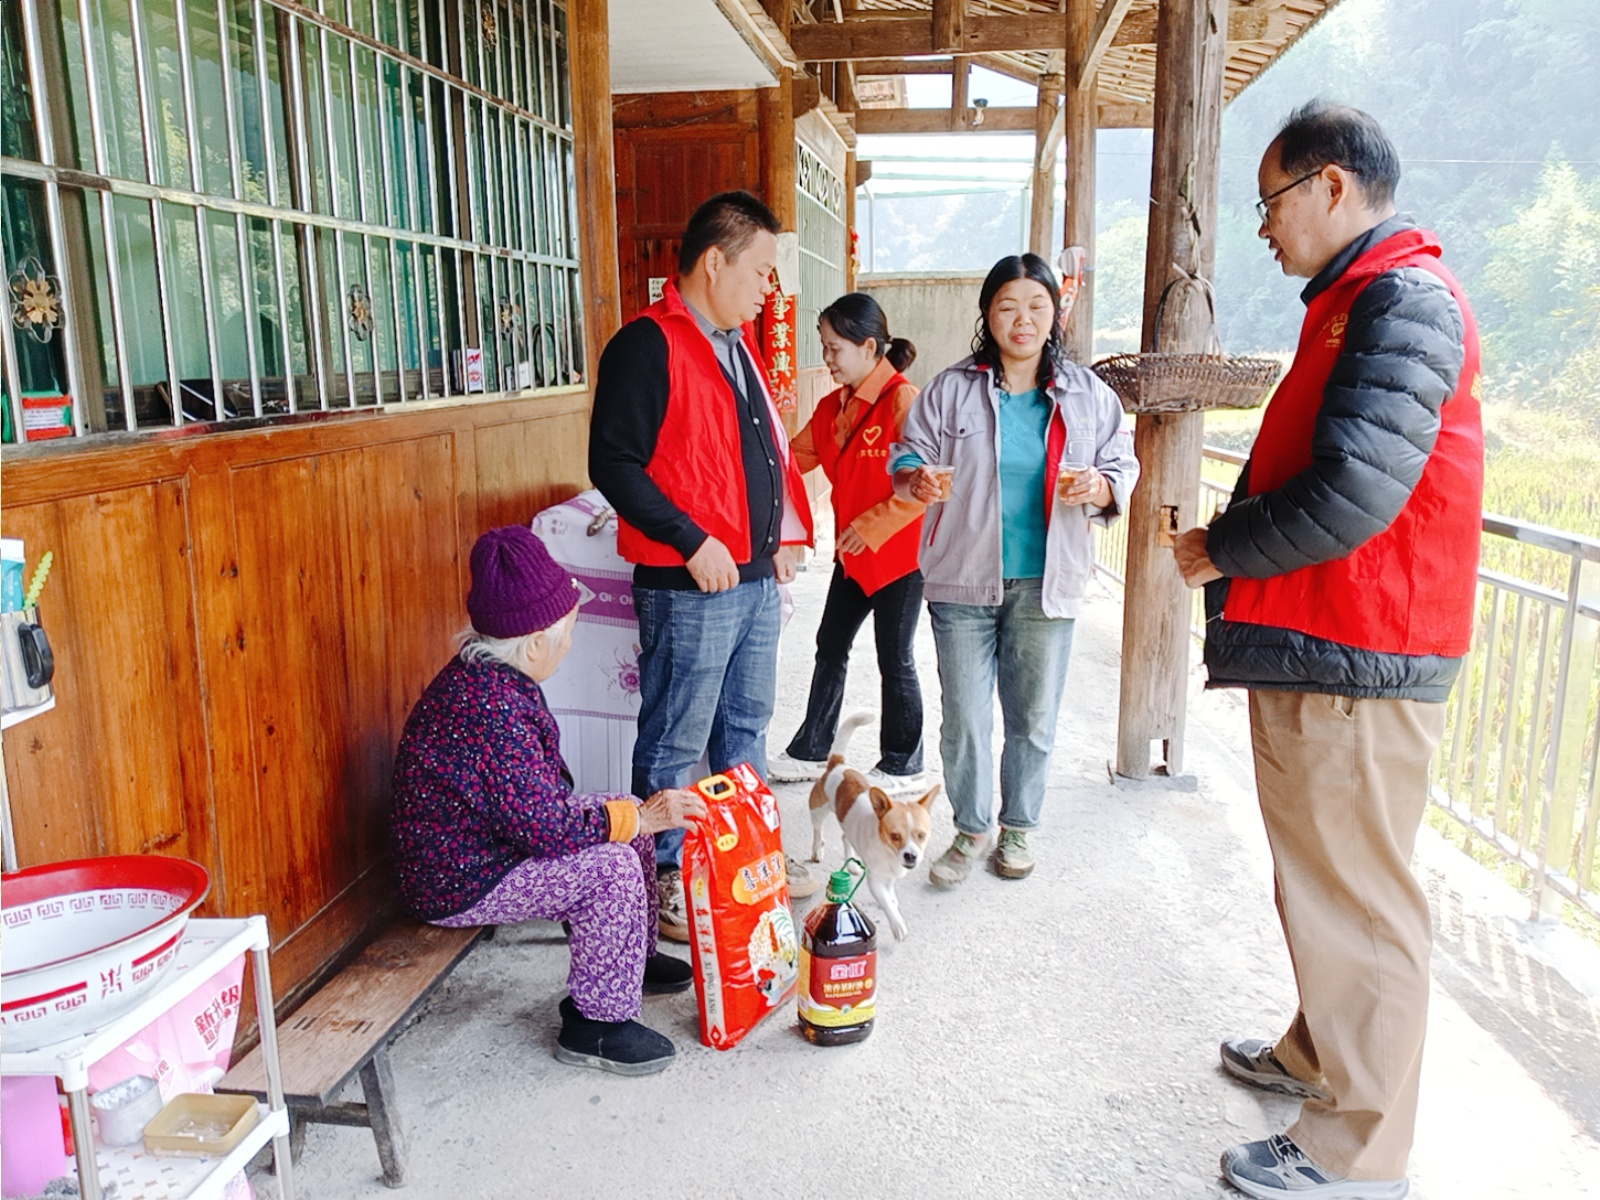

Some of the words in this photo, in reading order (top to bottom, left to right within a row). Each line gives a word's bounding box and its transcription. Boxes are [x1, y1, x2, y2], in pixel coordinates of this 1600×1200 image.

[194, 984, 239, 1035] 新升级
[707, 993, 717, 1015] YANG
